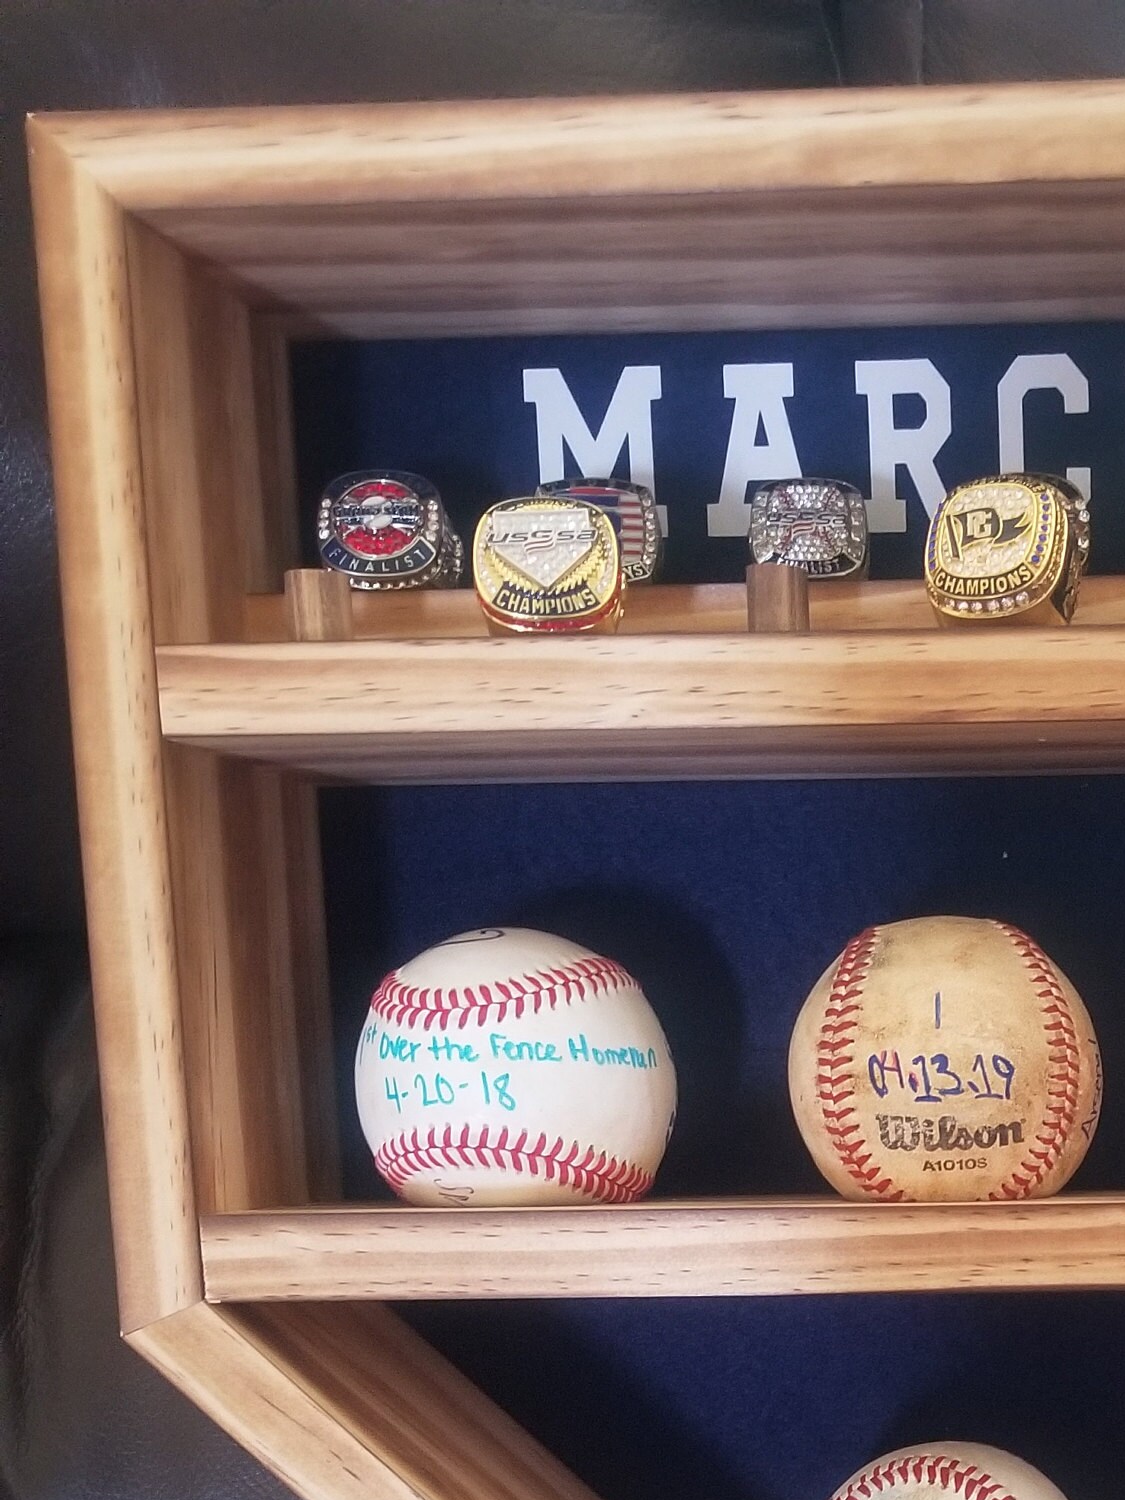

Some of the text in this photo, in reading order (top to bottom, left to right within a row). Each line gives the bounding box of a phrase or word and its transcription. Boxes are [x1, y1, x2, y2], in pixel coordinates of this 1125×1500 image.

[328, 547, 426, 572] FINALIST
[935, 564, 1032, 596] CHAMPIONS
[496, 587, 597, 615] CHAMPIONS
[379, 1031, 422, 1063] Over
[427, 1035, 480, 1063] the
[489, 1032, 563, 1063] Fence
[384, 1070, 517, 1114] 4-20-18
[874, 1113, 1027, 1153] Wilson
[921, 1157, 989, 1173] A1010S
